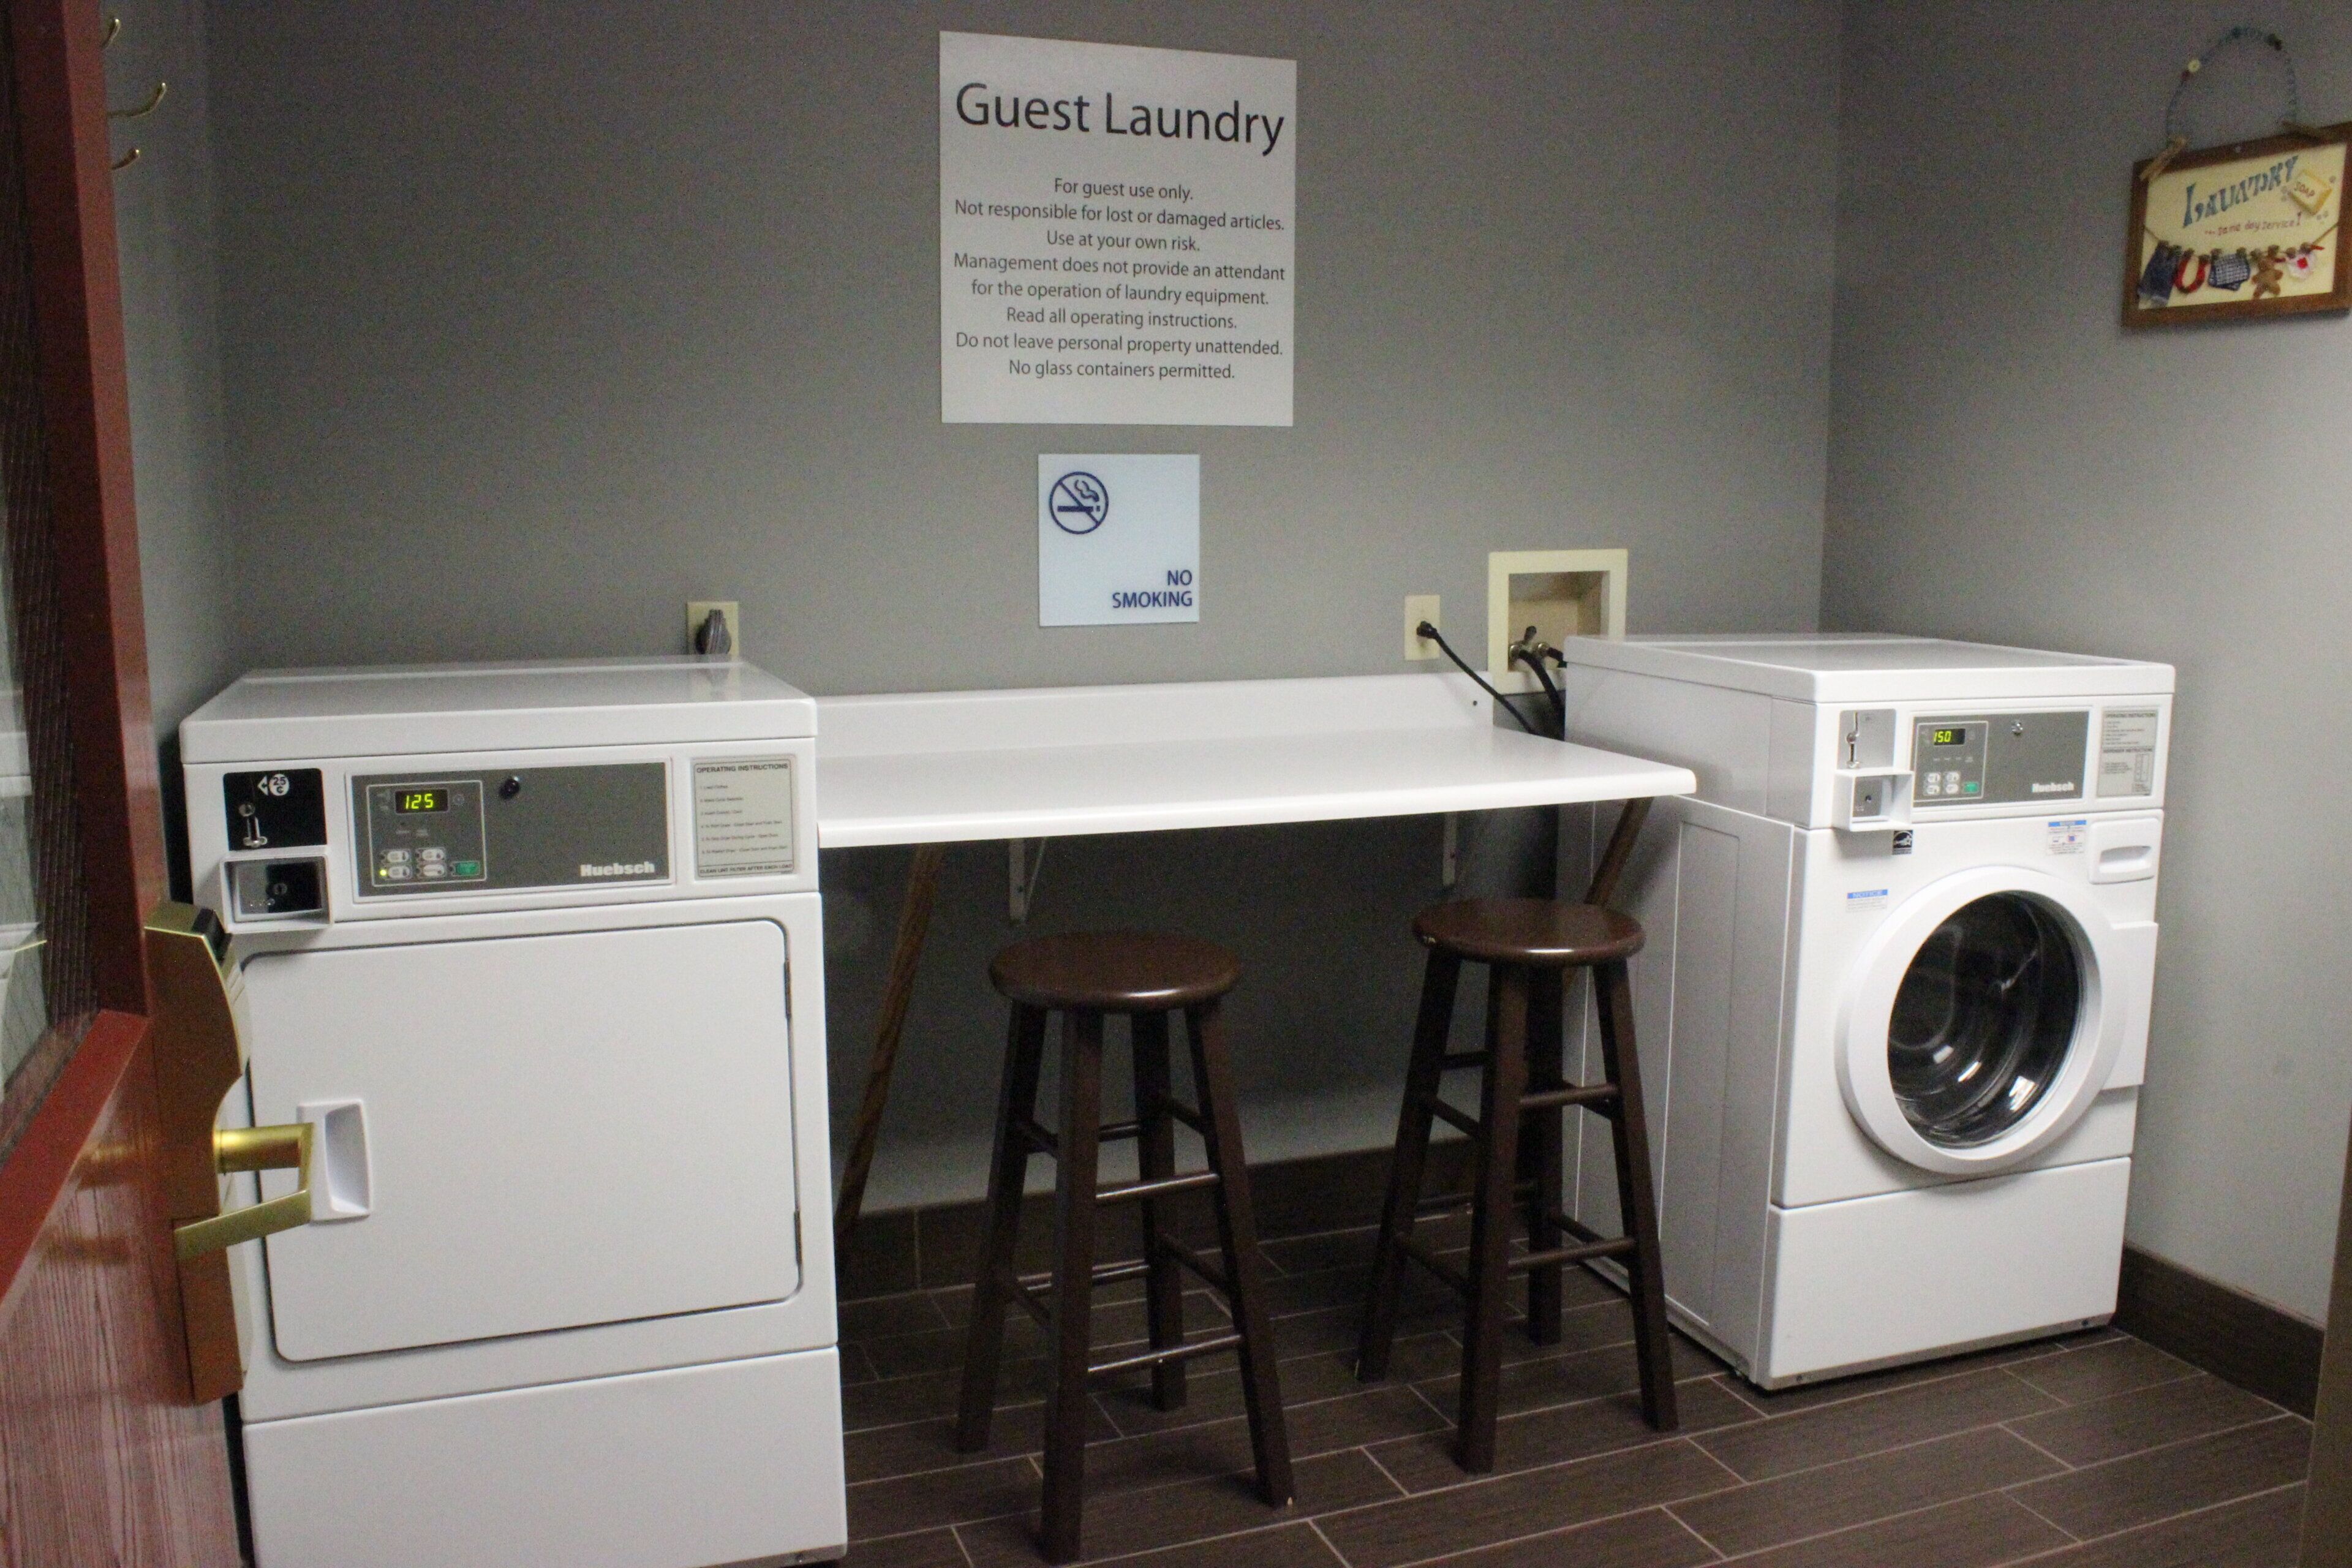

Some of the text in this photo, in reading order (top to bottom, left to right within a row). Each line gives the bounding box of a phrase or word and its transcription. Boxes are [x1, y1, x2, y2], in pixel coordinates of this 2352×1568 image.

[956, 82, 1284, 157] Guest Laundry
[1055, 178, 1193, 203] For guest use only.
[956, 200, 1284, 230] Not responsible for lost or damaged articles.
[1047, 230, 1200, 251] Use at your own risk.
[954, 253, 1285, 280] Management does not provide an attendant
[971, 279, 1268, 306] for the operation of laundry equipment.
[1007, 307, 1237, 329] Read all operating instructions.
[957, 332, 1283, 355] Do not leave personal property unattended.
[1009, 360, 1234, 380] No glass containers permitted.
[1167, 570, 1192, 586] NO
[1112, 590, 1193, 608] SMOKING
[1934, 731, 1951, 743] 150
[405, 794, 433, 809] 125
[581, 861, 655, 876] Huebsch
